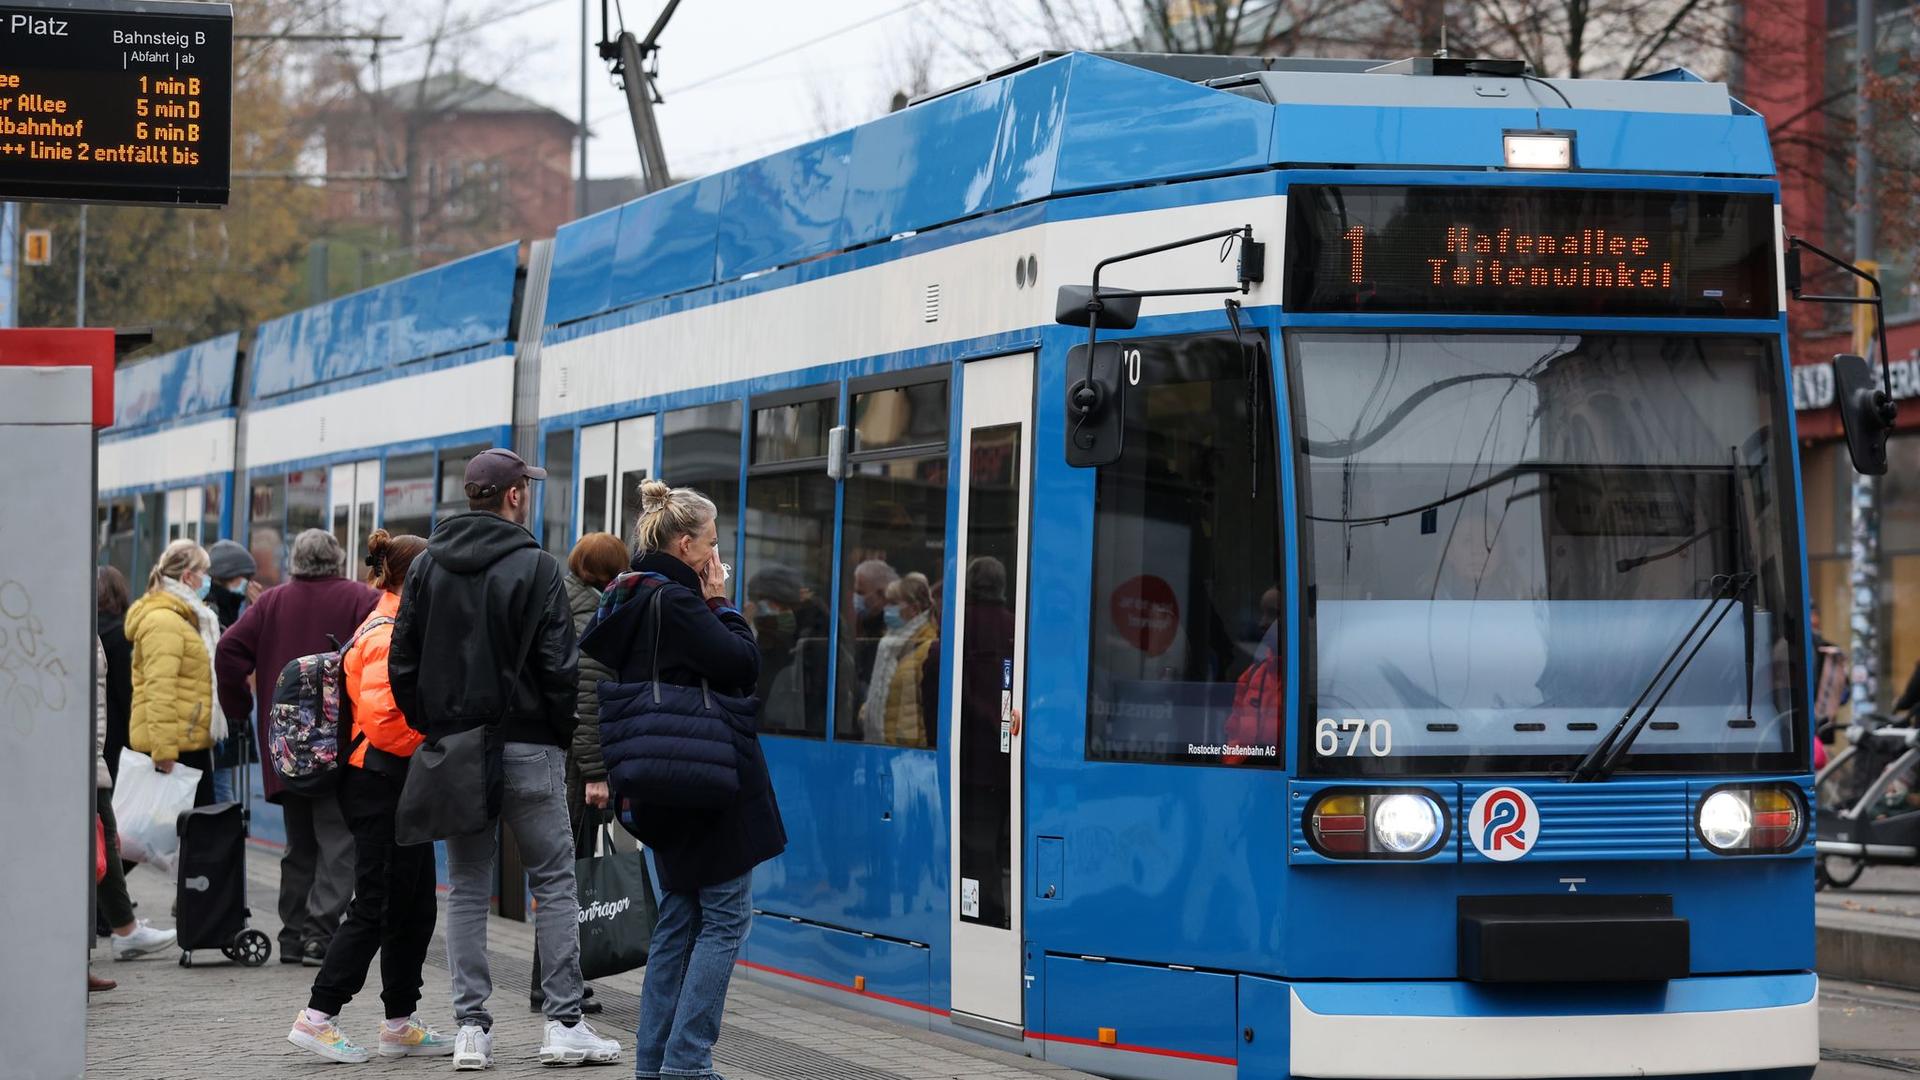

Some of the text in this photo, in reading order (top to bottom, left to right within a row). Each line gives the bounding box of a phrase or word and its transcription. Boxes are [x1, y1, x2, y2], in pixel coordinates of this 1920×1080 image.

[11, 14, 69, 36] Platz
[113, 30, 206, 48] Bahnsteig B
[131, 51, 195, 64] Abfahrt ab
[140, 75, 200, 96] 1 min B
[0, 94, 67, 113] r Allee
[137, 99, 200, 119] 5 min D
[136, 122, 200, 142] 6 min B
[31, 141, 73, 160] Linie
[78, 143, 89, 161] 2
[95, 144, 168, 164] entfällt
[172, 147, 199, 165] bis
[1447, 226, 1650, 256] Hafenallee
[1342, 225, 1365, 284] 1
[1427, 258, 1672, 288] Toitenwinkel
[1315, 717, 1392, 757] 670
[1188, 743, 1276, 757] Rostocker Straßenbahn AG
